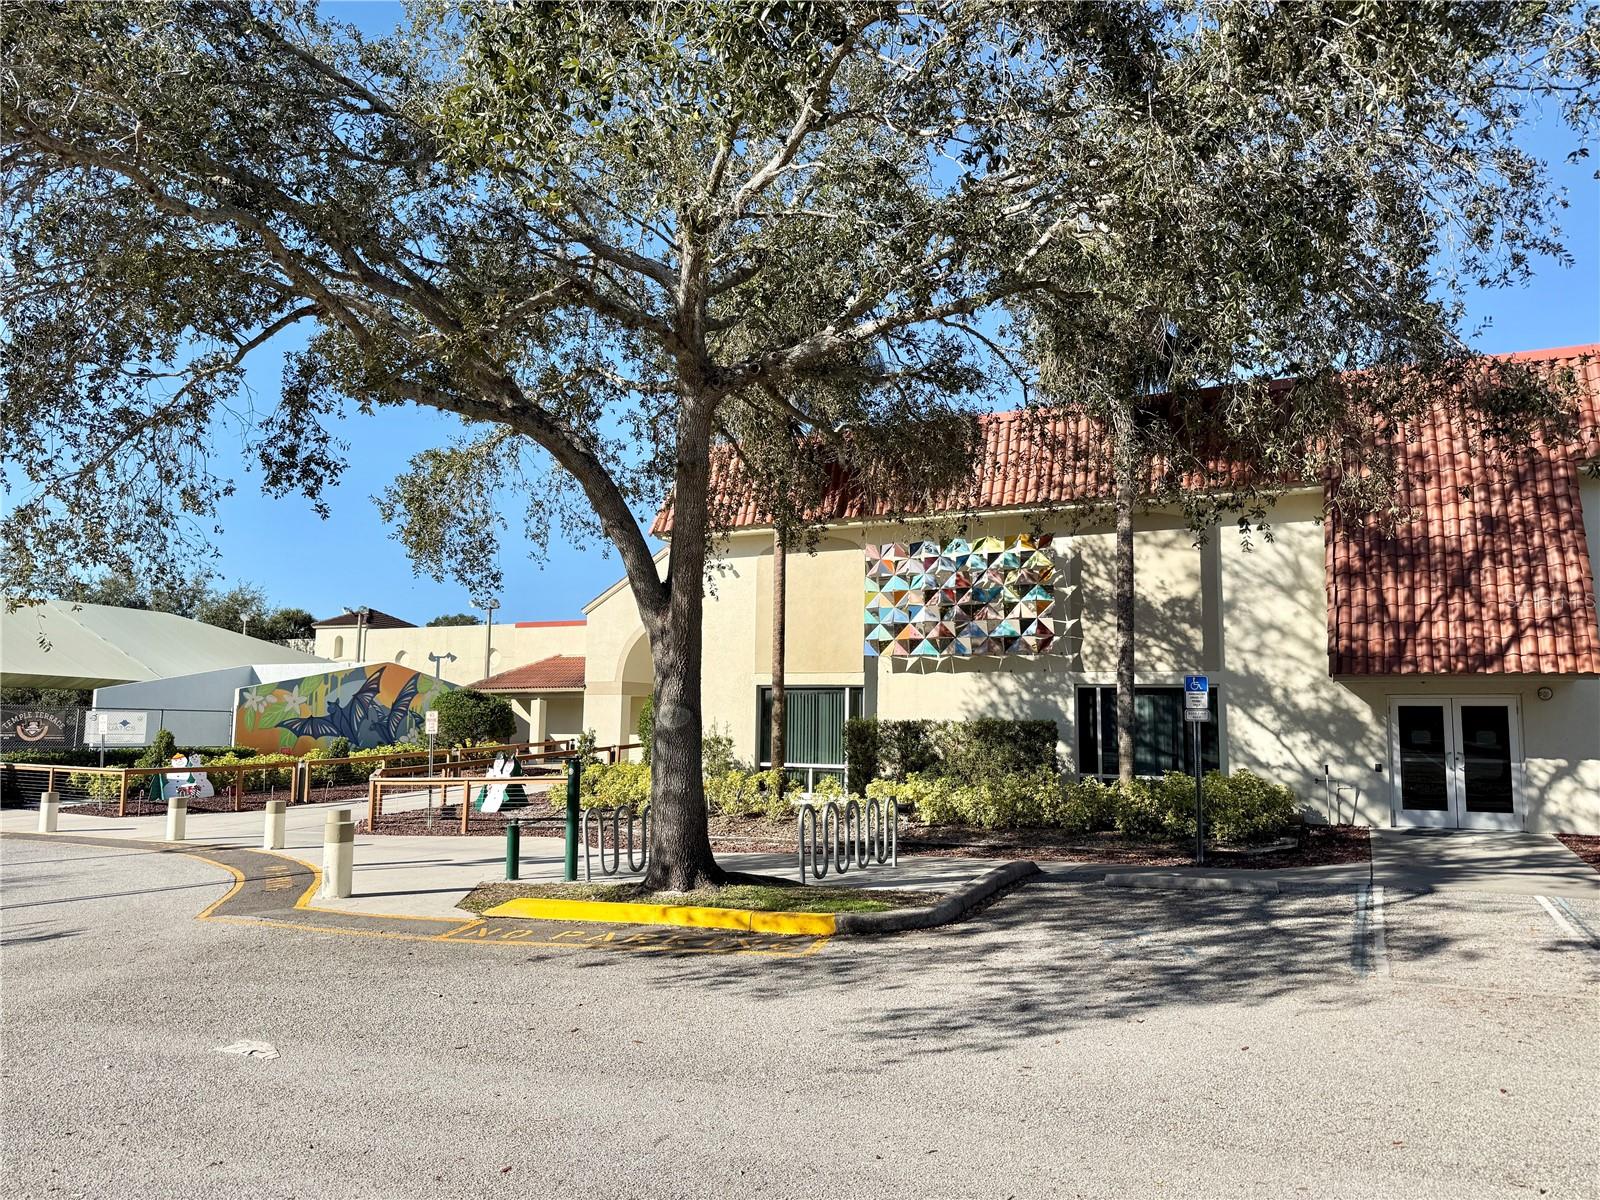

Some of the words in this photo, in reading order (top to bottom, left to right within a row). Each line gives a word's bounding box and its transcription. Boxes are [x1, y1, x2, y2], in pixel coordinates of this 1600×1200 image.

[2, 711, 32, 729] TEMPLE
[34, 711, 66, 730] TERRACE
[463, 927, 533, 940] NO
